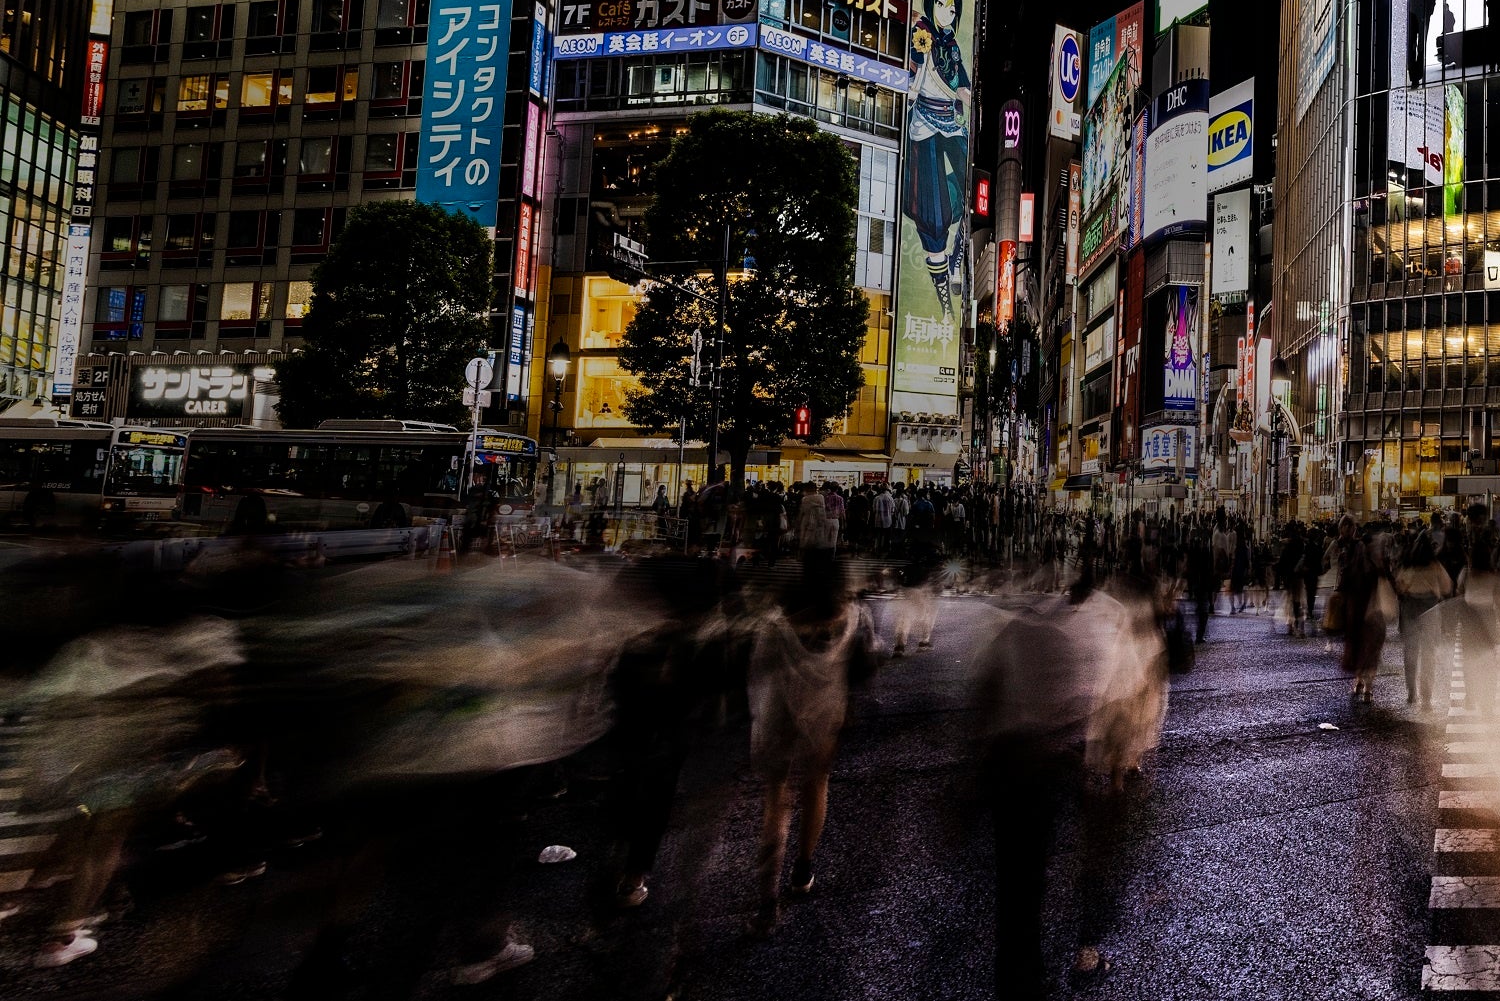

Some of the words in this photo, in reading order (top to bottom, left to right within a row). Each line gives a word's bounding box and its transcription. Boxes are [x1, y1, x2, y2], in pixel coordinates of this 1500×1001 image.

[563, 3, 592, 25] 7F
[598, 0, 631, 17] Café
[559, 36, 598, 54] AEON
[608, 29, 722, 54] 英会話イーオン
[729, 29, 746, 42] 6F
[764, 30, 803, 55] AEON
[809, 43, 907, 86] 英会話イーオン
[1060, 50, 1080, 86] UC
[428, 5, 473, 188] アイシティ
[463, 4, 502, 187] コンタクトの
[1166, 85, 1188, 113] DHC
[84, 116, 98, 125] 7F
[1004, 110, 1020, 148] 109
[1070, 117, 1080, 130] VISA
[1207, 119, 1248, 156] IKEA
[73, 206, 91, 216] 5F
[70, 255, 84, 278] 内科
[63, 281, 81, 327] 産婦人科
[902, 311, 955, 361] 原神
[78, 369, 92, 386] 薬
[94, 370, 109, 384] 2F
[75, 389, 106, 403] 処方せん
[81, 403, 98, 416] 受付
